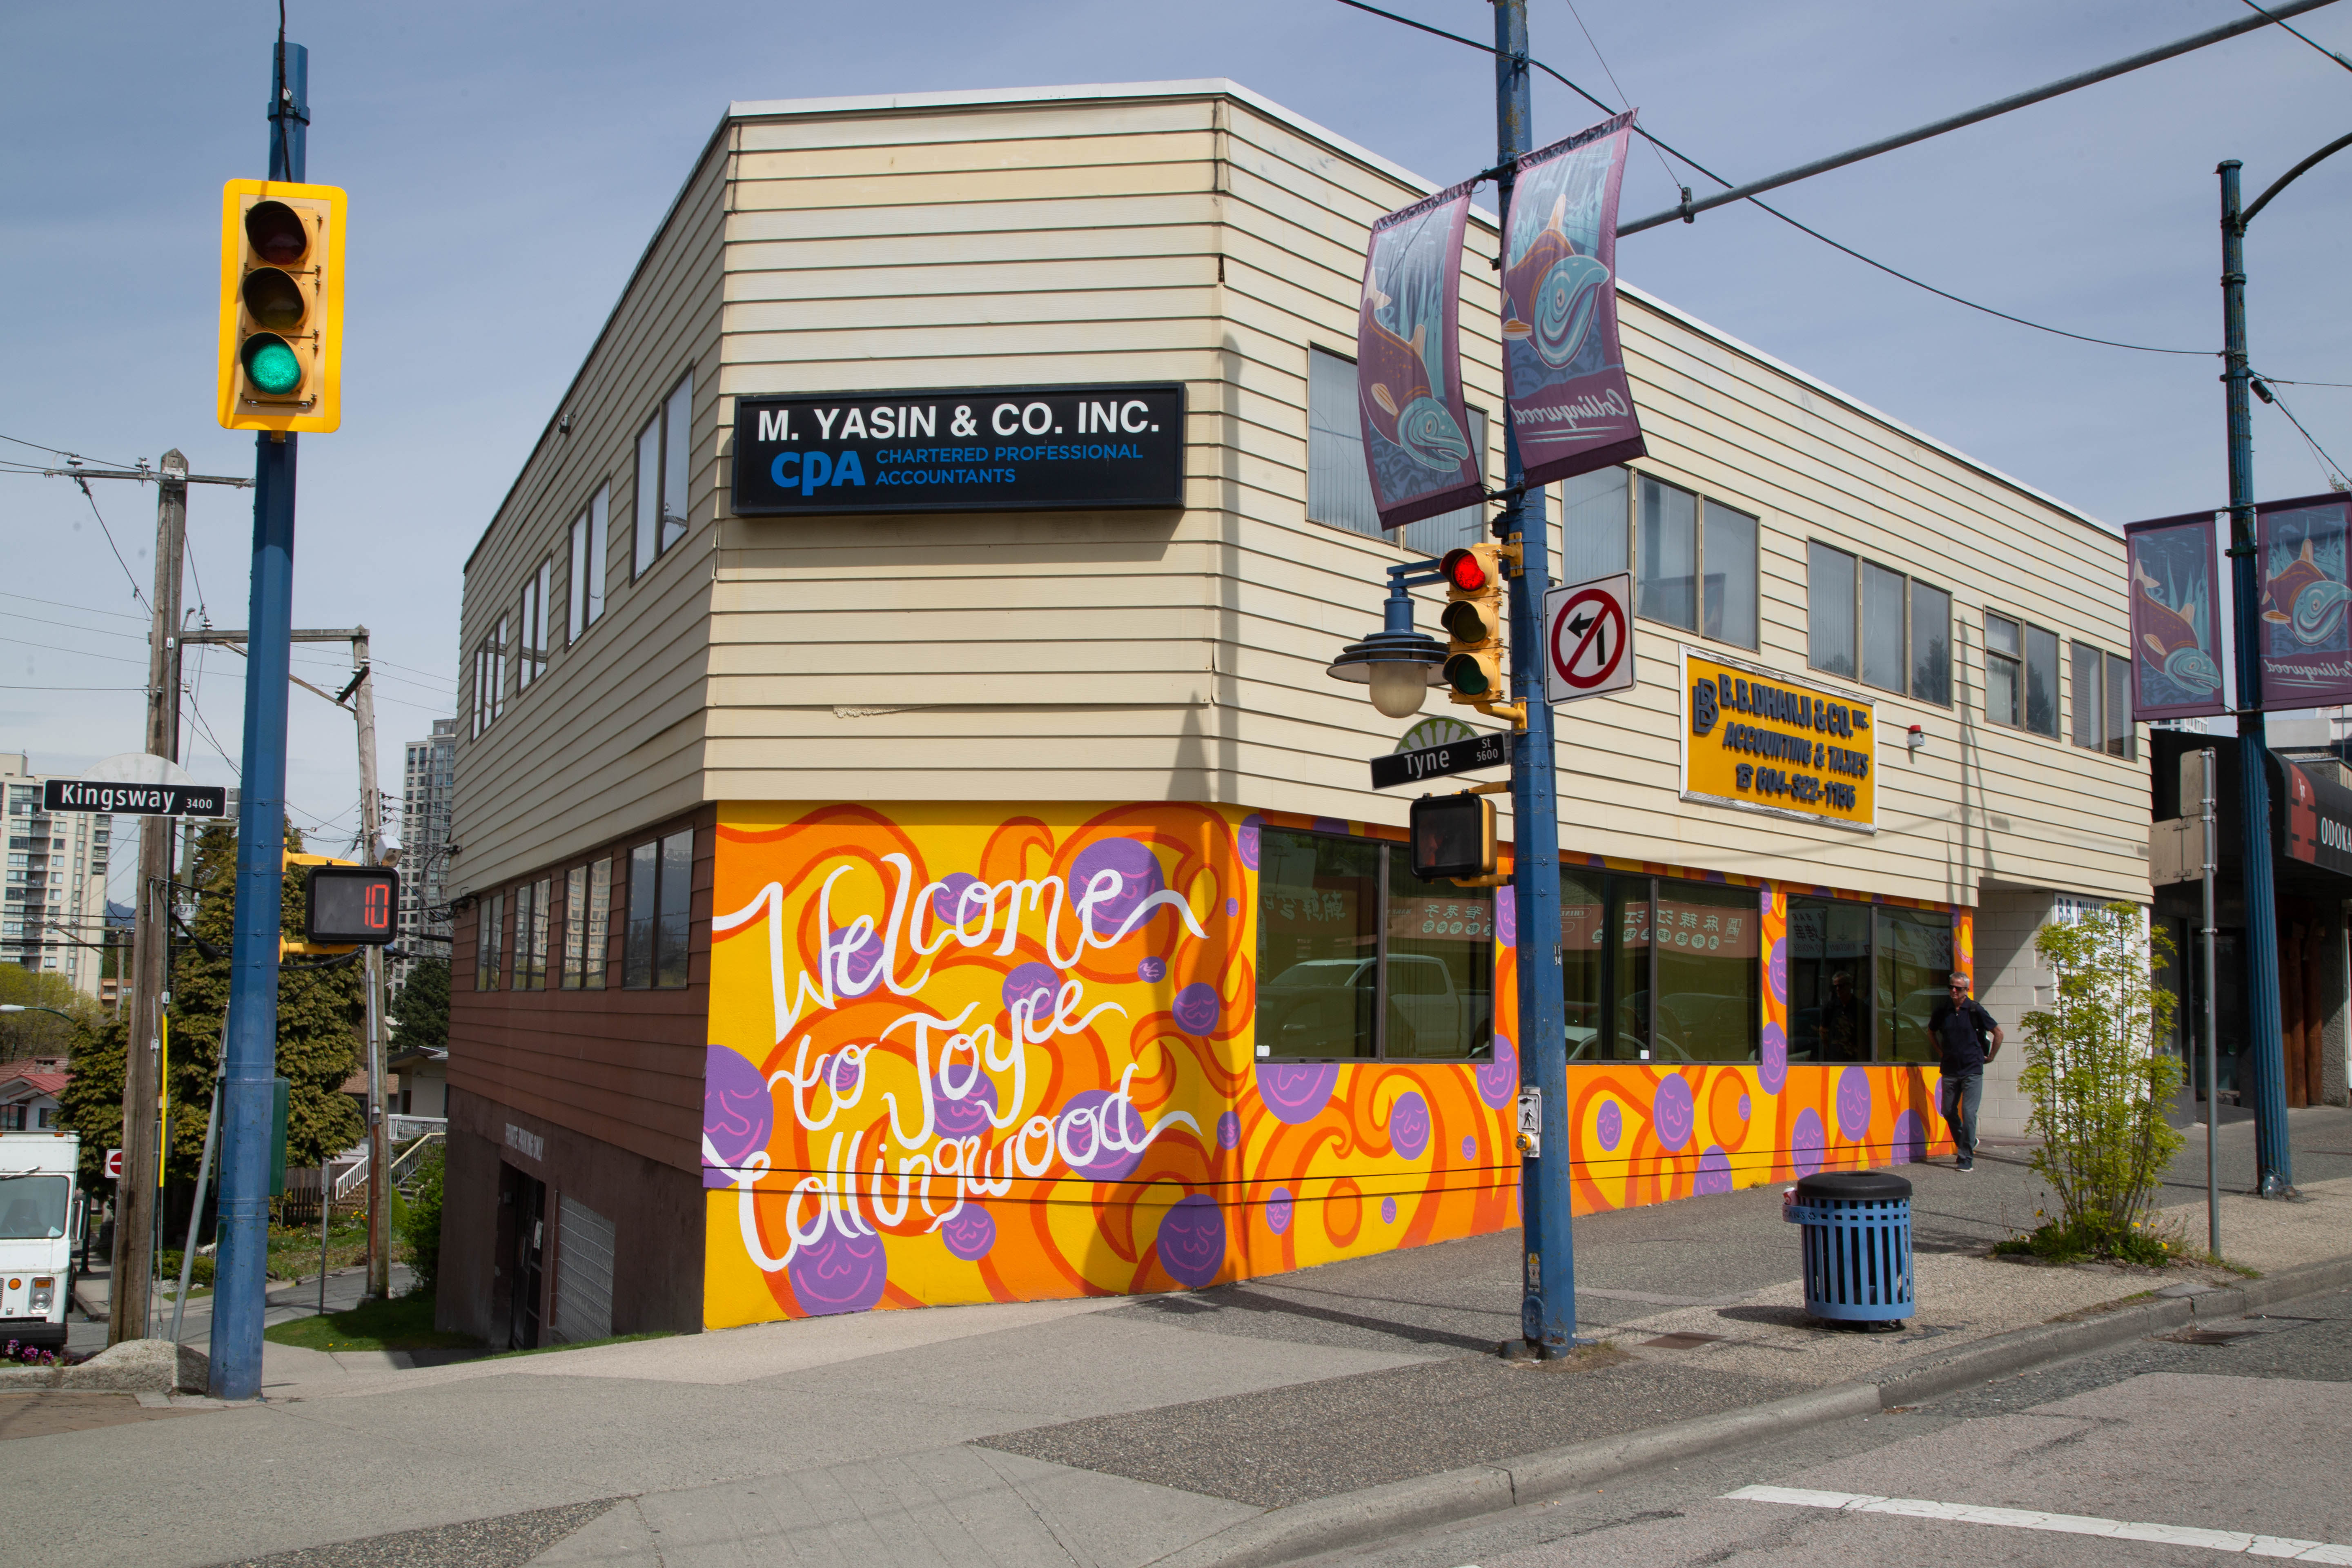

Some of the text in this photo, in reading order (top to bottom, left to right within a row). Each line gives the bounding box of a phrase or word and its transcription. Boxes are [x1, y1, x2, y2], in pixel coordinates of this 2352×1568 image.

[758, 400, 1159, 441] M. YASIN & CO. INC.
[876, 443, 1143, 464] CHARTERED PROFESSIONAL
[875, 468, 1016, 486] ACCOUNTANTS
[1814, 699, 1827, 733] &
[1827, 702, 1853, 738] CO.
[1853, 709, 1869, 729] INC.
[1477, 748, 1498, 762] 5600
[1482, 738, 1490, 748] St
[1723, 721, 1869, 777] ACCOUNTING & TAXES
[1404, 750, 1450, 779] Tyne
[61, 784, 213, 813] Kingsway 3400
[1756, 766, 1856, 809] 604-322-1156
[365, 884, 389, 929] 10
[712, 852, 1210, 1045] Welcome
[768, 979, 1128, 1149] to Joyce
[702, 1063, 1203, 1272] Collingwood
